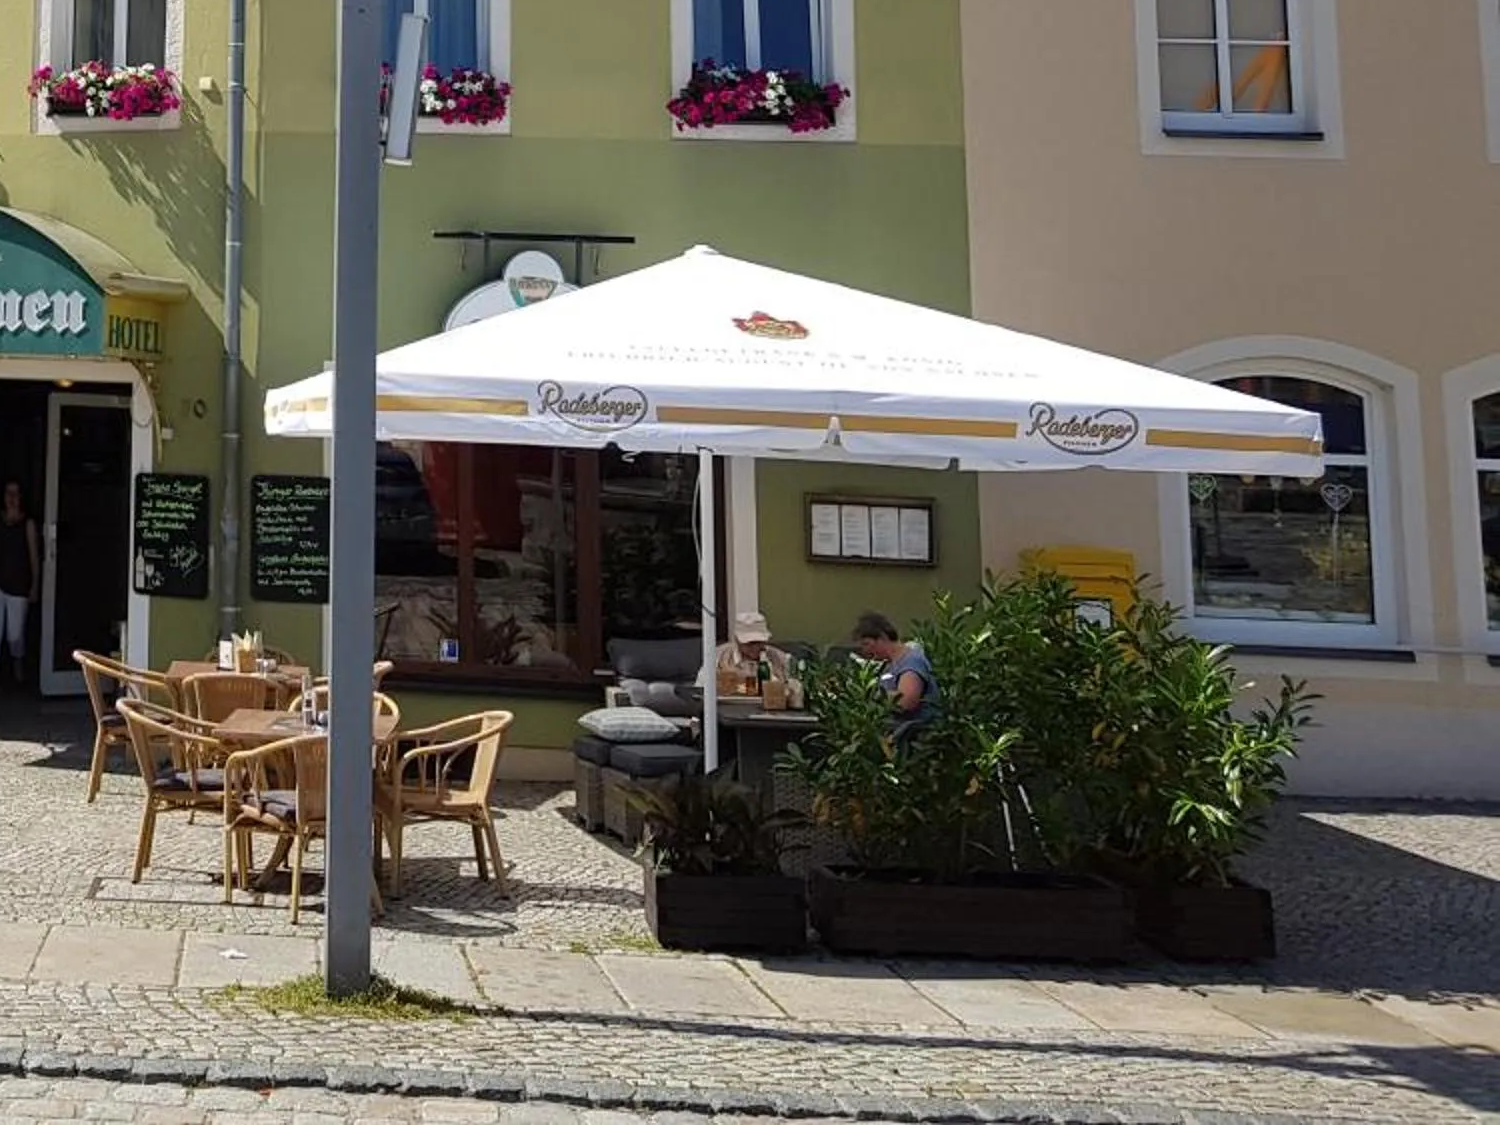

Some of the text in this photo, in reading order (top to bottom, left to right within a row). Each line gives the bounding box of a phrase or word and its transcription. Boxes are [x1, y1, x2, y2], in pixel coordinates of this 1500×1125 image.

[109, 315, 162, 354] HOTEL
[538, 380, 648, 429] Radeberger
[1025, 402, 1139, 451] Radeberger
